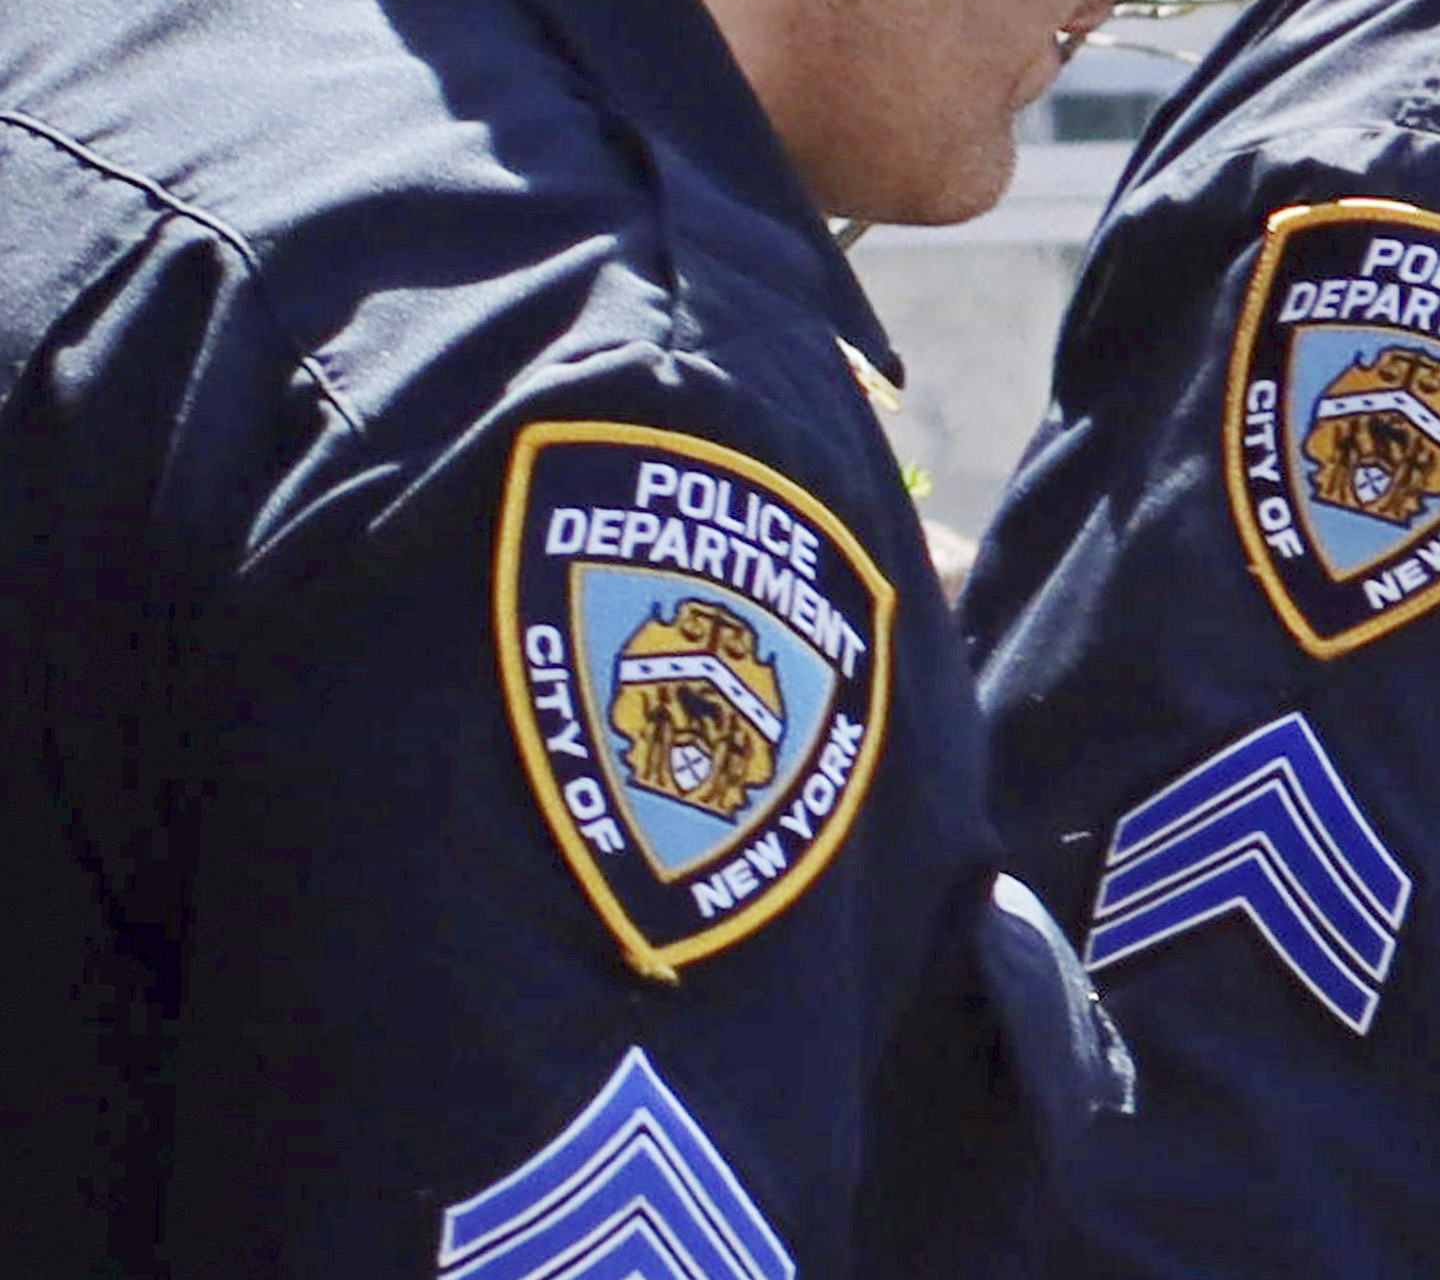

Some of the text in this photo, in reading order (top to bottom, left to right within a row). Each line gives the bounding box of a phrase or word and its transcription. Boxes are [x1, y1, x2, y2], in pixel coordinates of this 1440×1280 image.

[635, 462, 820, 580] POLICE
[1245, 380, 1305, 562] CITY OF
[545, 508, 867, 679] DEPARTMENT
[525, 624, 624, 857] CITY OF
[690, 713, 866, 919] NEW YORK
